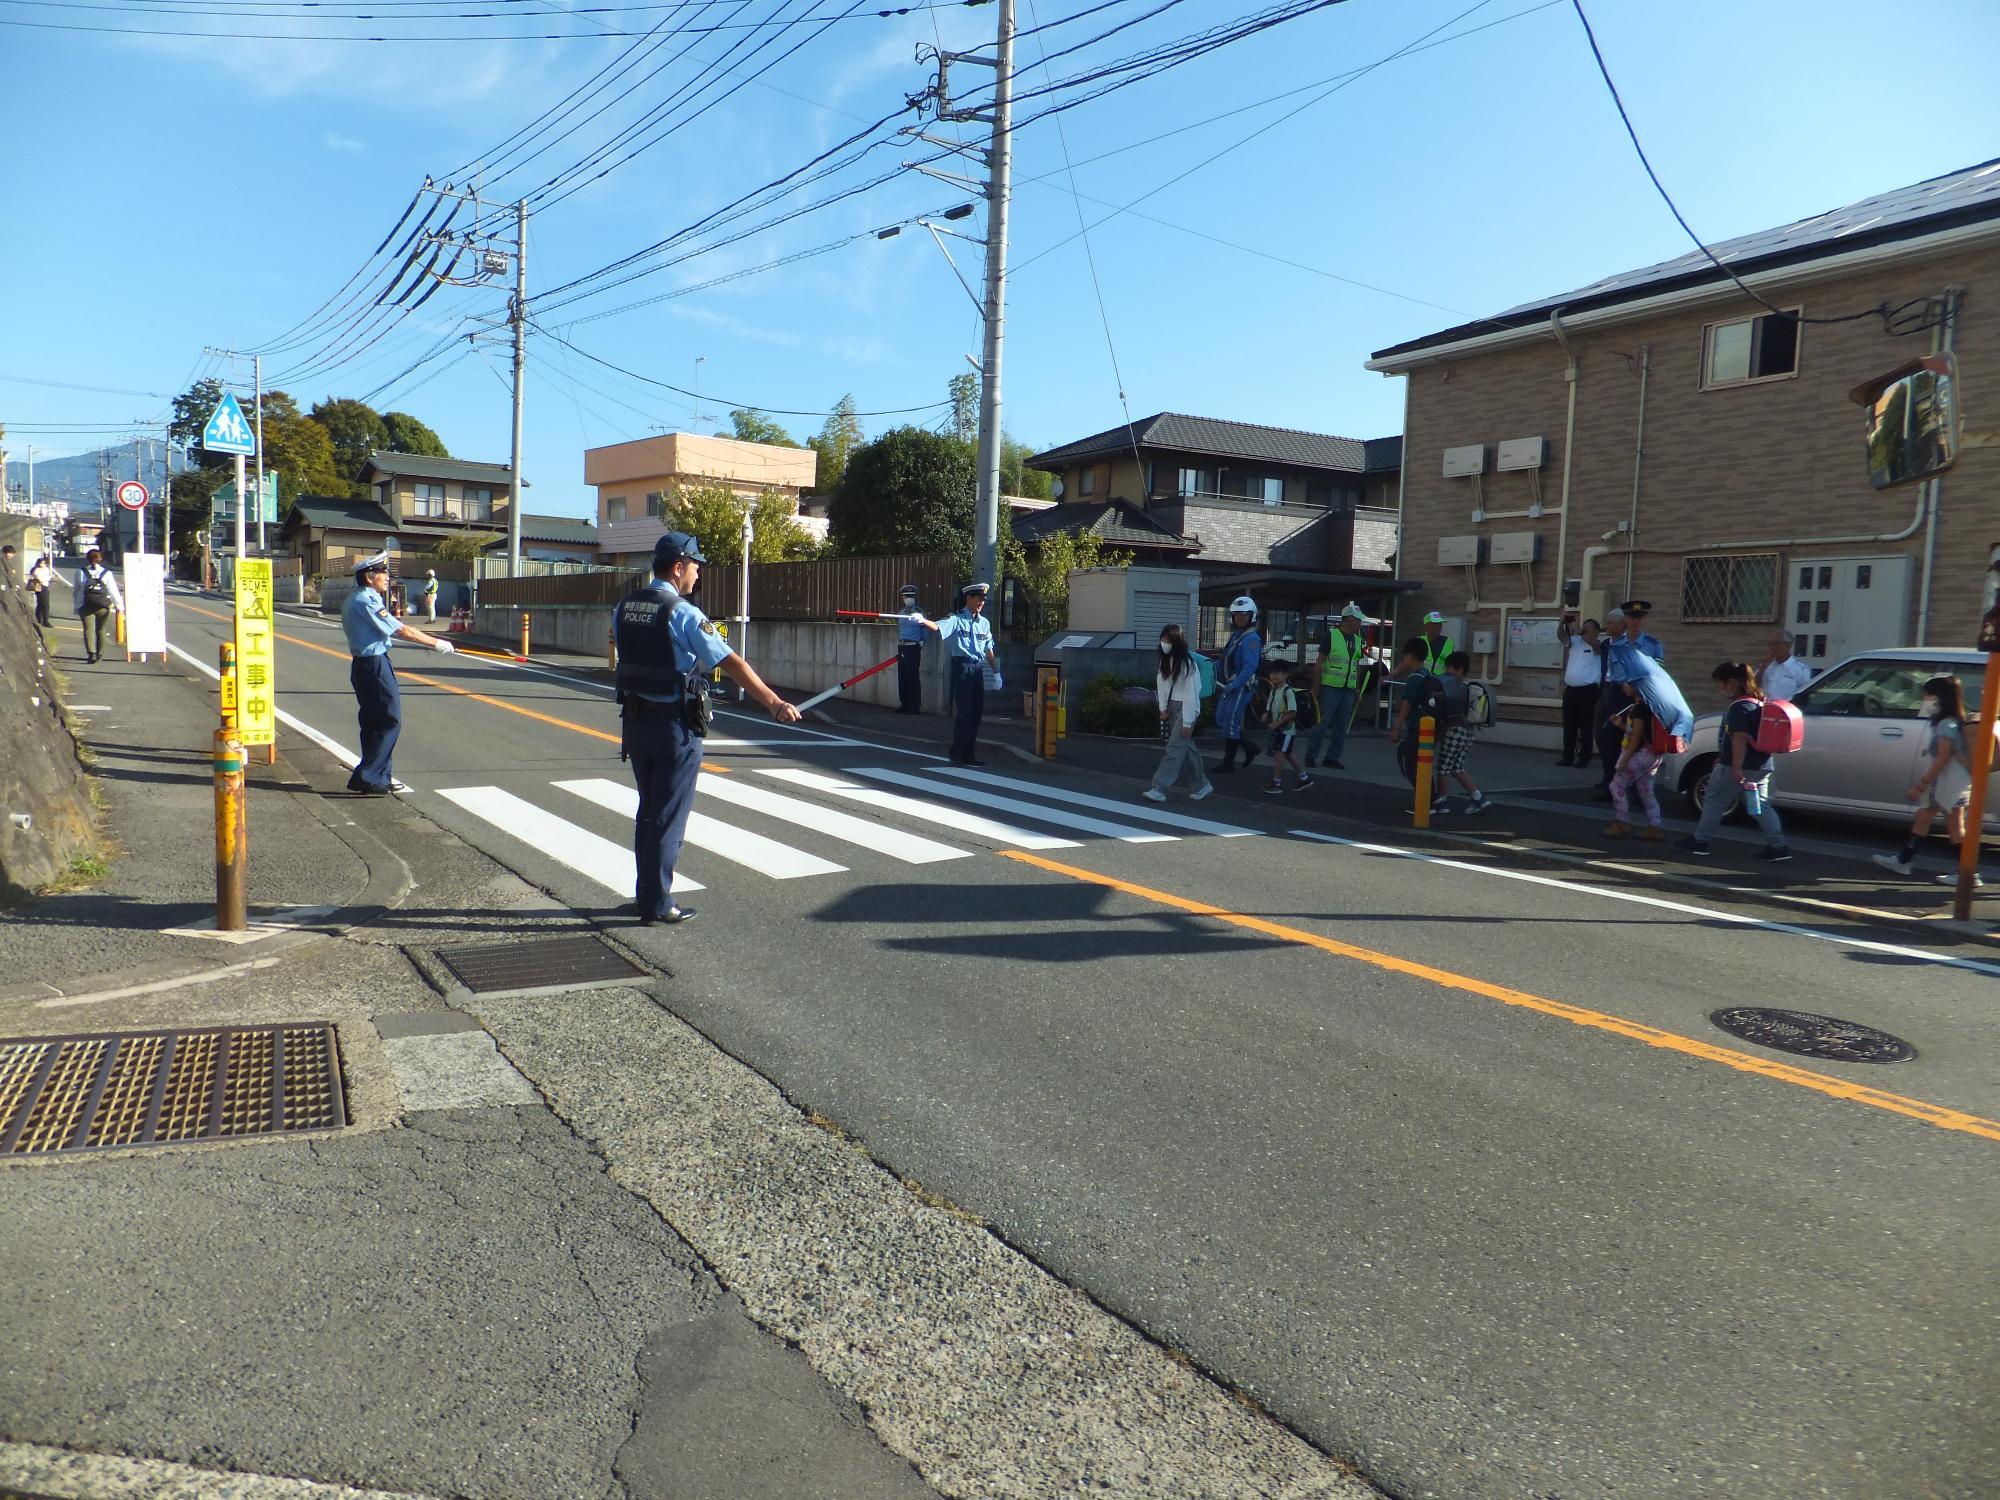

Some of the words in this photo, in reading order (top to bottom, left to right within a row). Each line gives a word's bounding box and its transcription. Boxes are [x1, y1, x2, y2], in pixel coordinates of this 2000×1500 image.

[124, 489, 142, 502] 30
[624, 612, 652, 623] POLICE
[245, 632, 266, 720] 工事中
